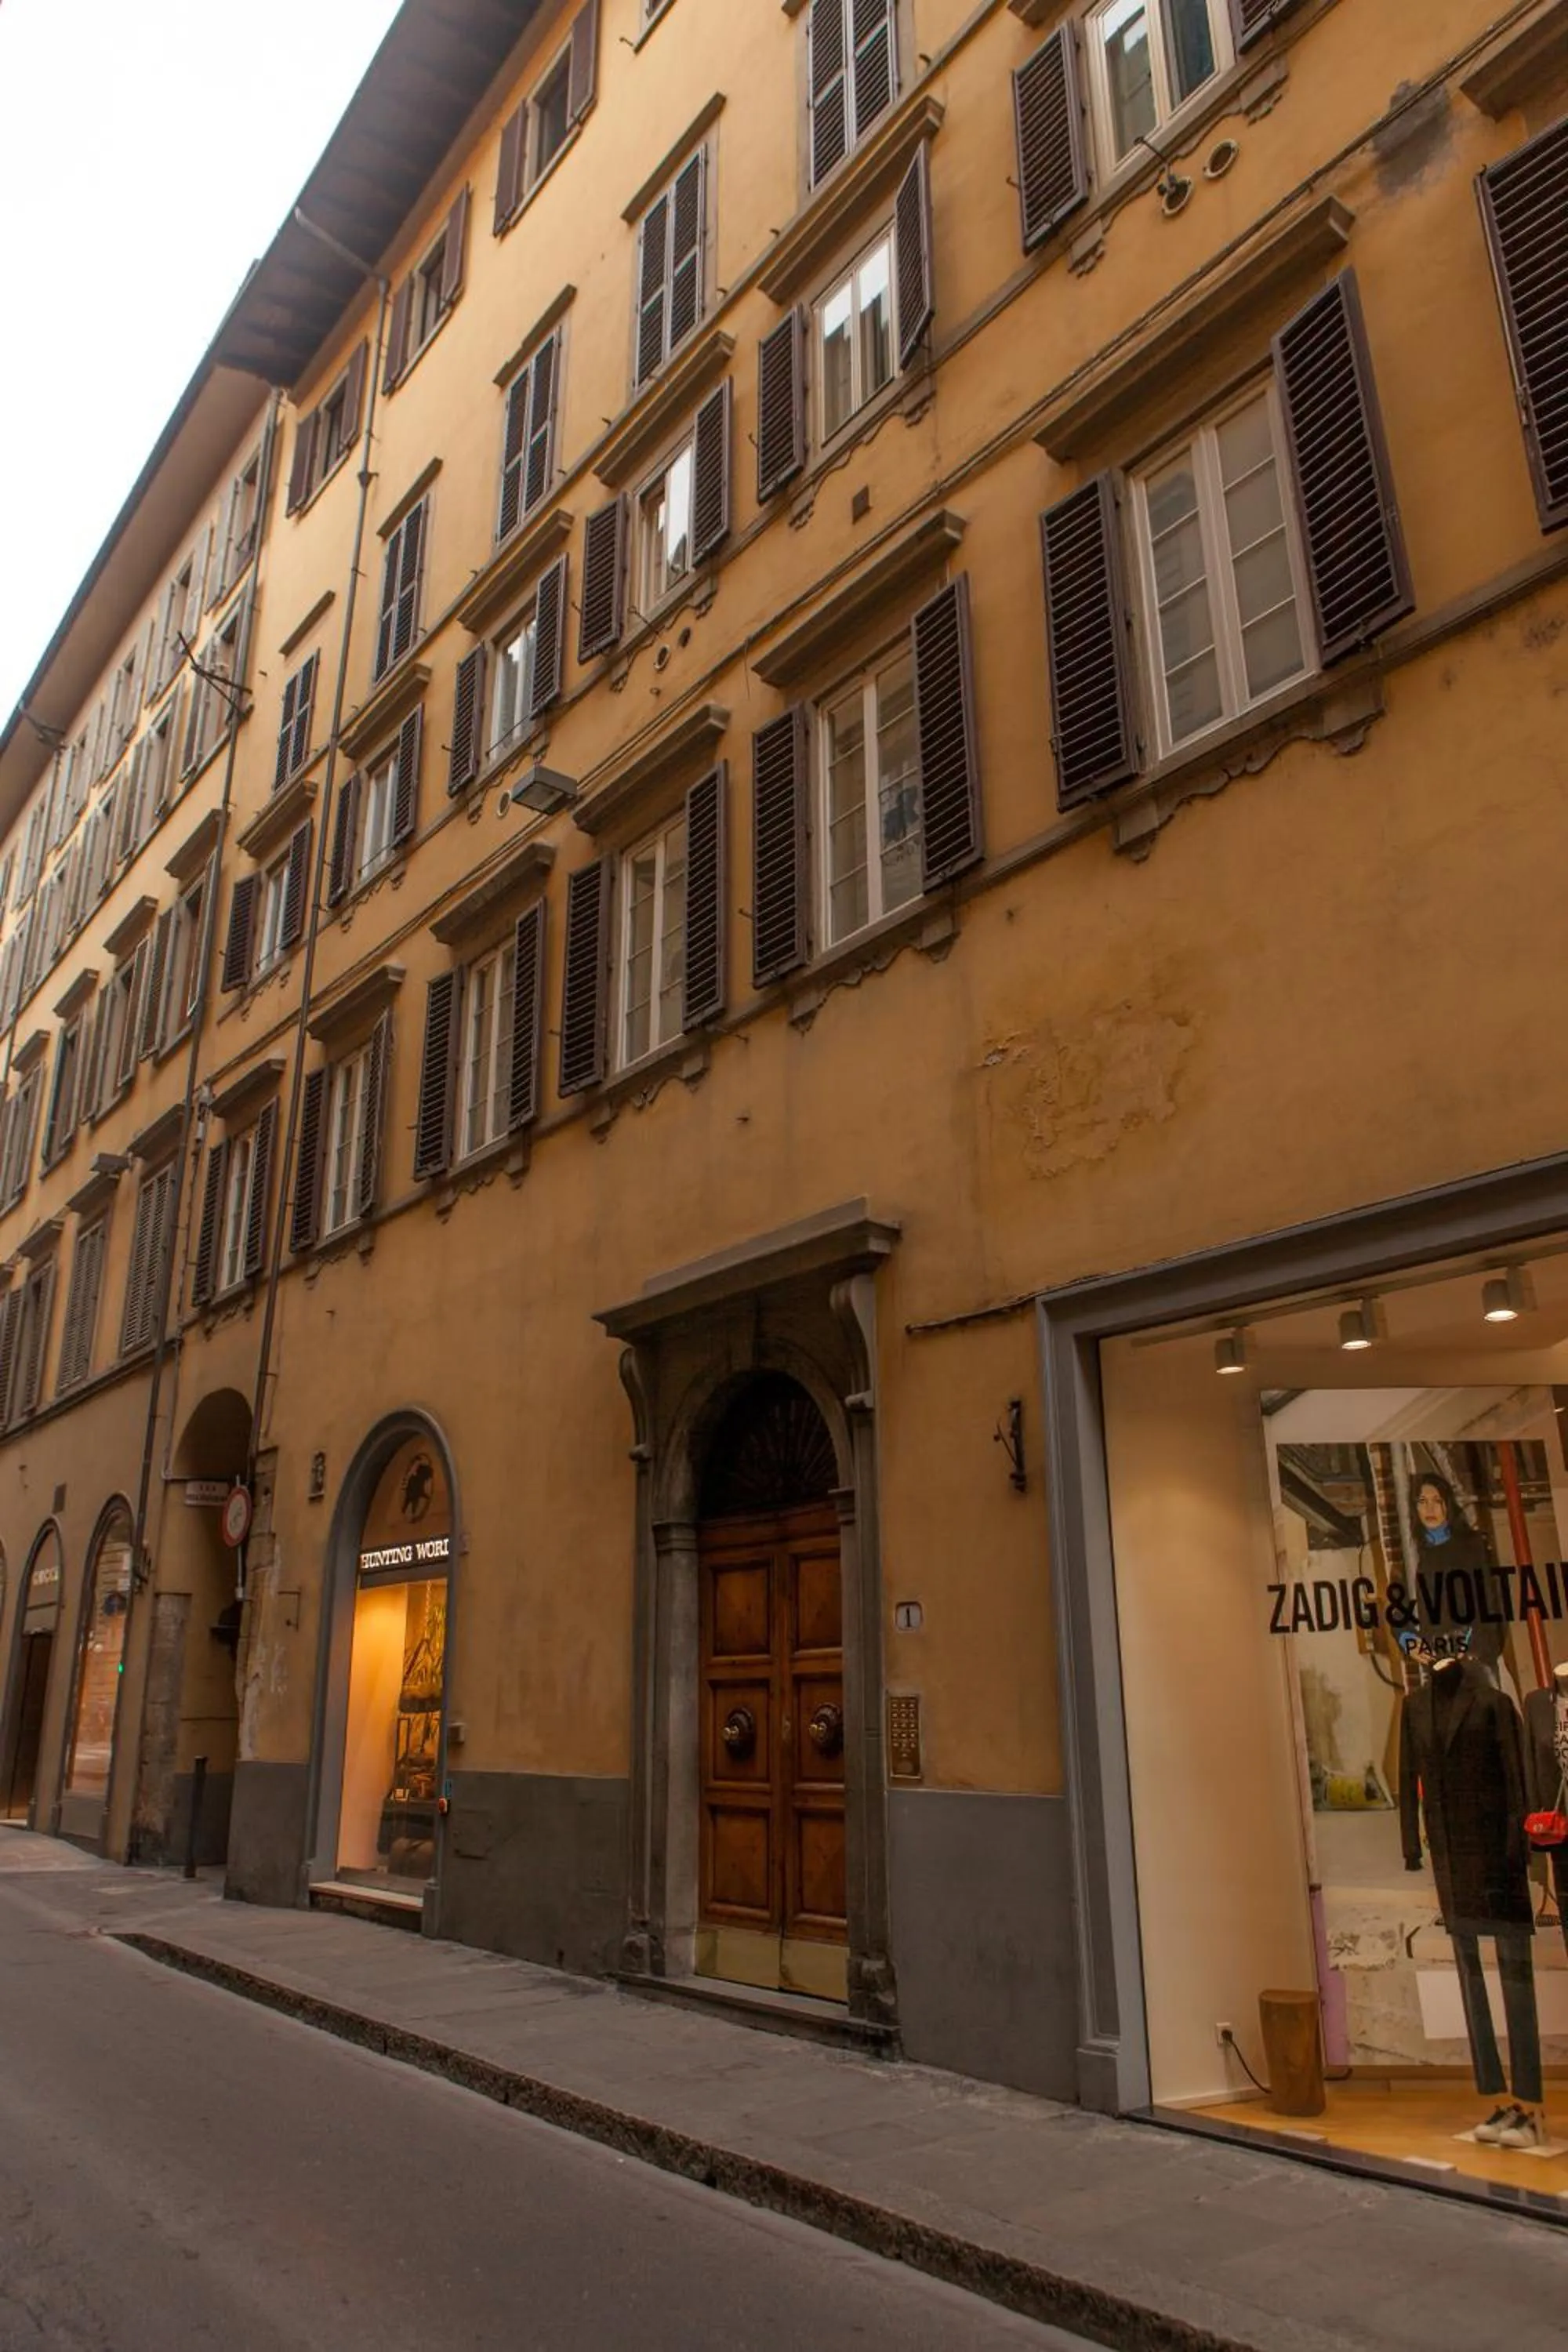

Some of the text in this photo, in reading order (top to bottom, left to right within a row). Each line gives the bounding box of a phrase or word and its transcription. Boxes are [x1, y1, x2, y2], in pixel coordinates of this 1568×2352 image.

[360, 1537, 449, 1569] HUNTING WORL
[1267, 1561, 1568, 1634] ZADIG & VOLTAI
[1405, 1635, 1470, 1657] PARIS
